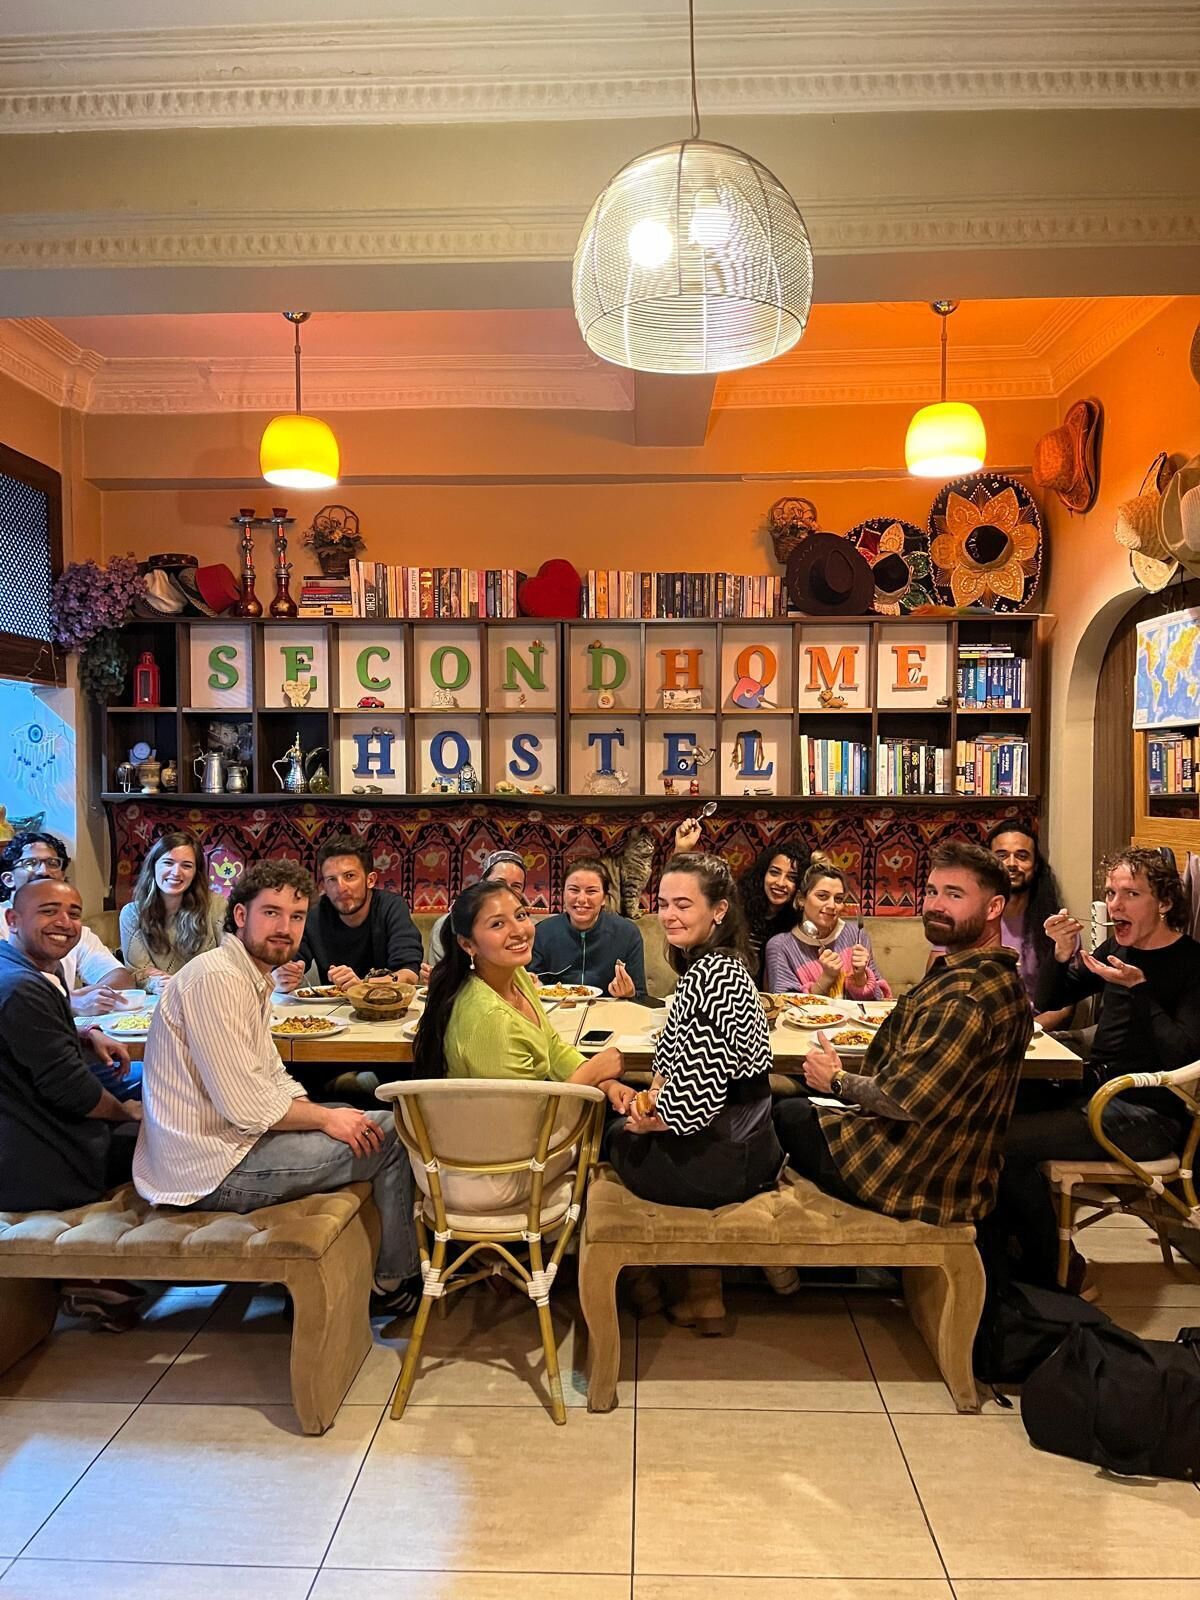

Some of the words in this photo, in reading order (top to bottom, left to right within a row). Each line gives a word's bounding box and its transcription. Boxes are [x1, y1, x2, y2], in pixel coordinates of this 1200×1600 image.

[366, 593, 376, 611] ECHO
[208, 645, 627, 691] SECOND
[661, 645, 928, 690] HOME
[352, 730, 774, 776] HOSTEL
